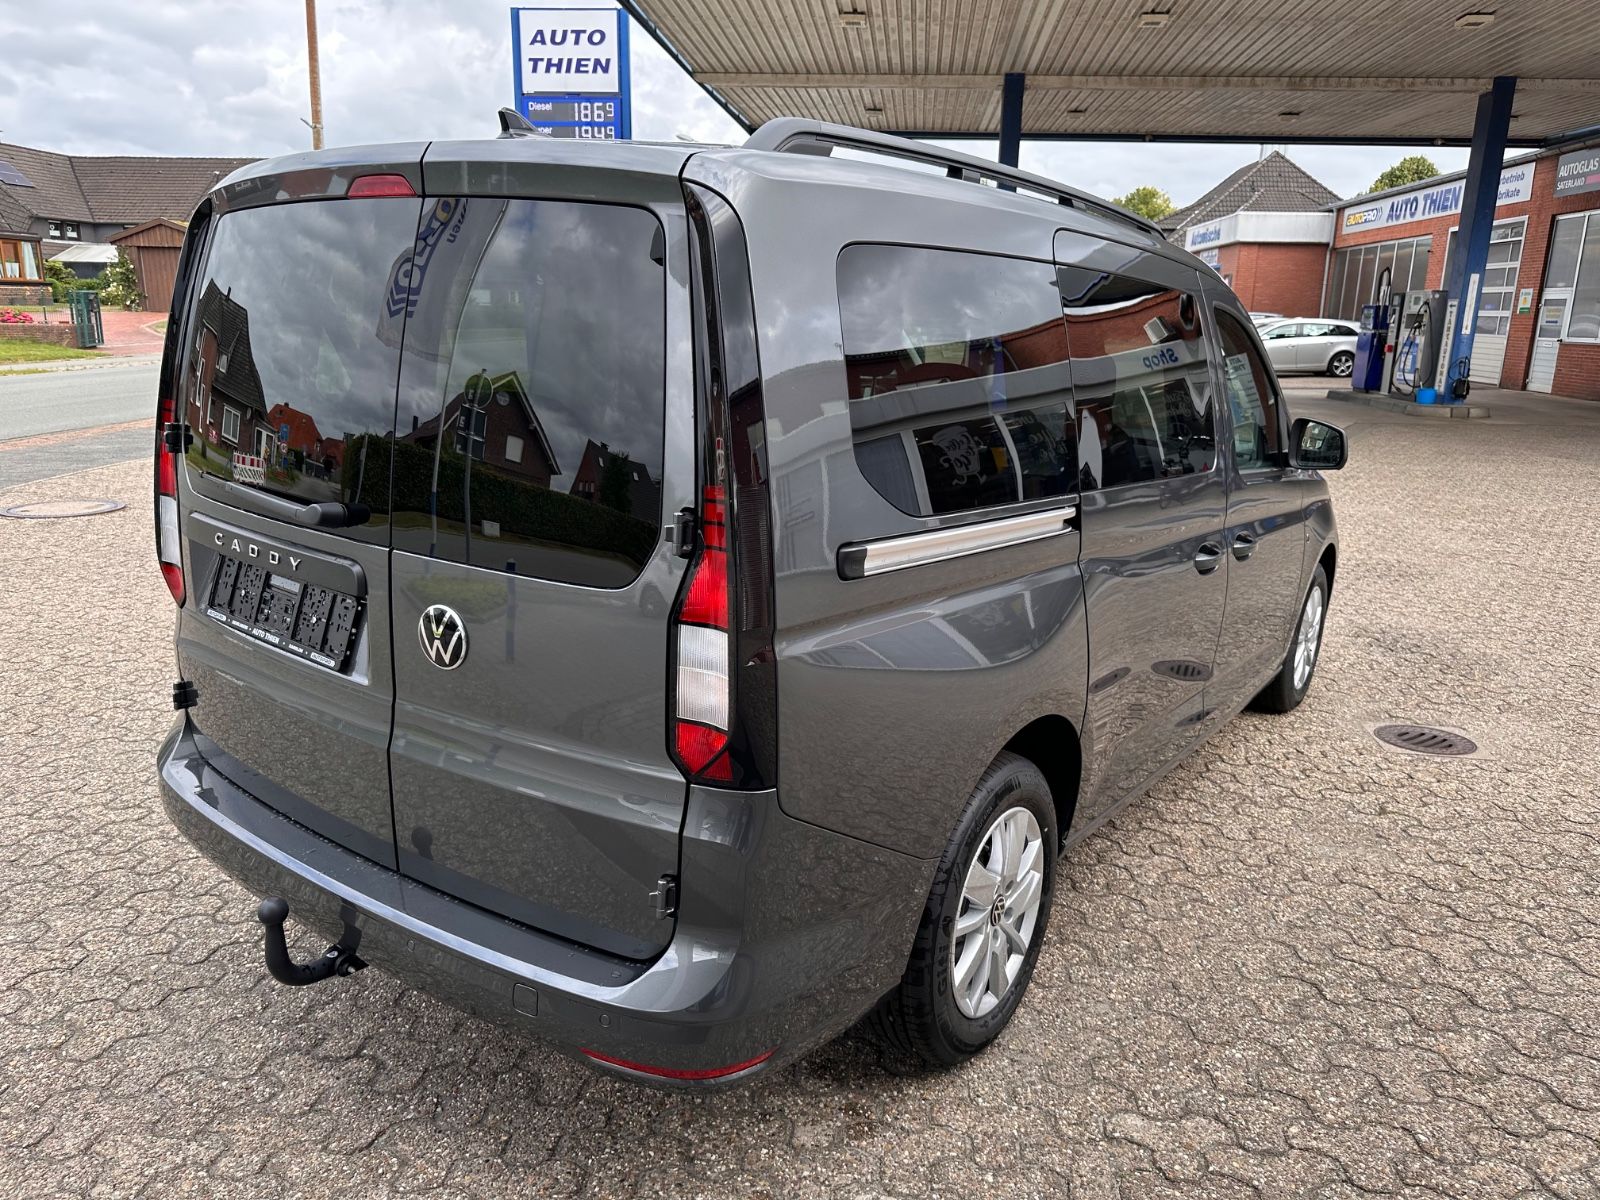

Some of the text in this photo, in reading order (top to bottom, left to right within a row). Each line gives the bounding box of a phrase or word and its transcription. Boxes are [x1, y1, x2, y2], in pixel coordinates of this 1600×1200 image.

[529, 29, 606, 46] AUTO
[528, 57, 611, 74] THIEN
[528, 101, 553, 111] Diesel
[1558, 157, 1600, 178] AUTOGLAS
[1556, 177, 1585, 190] SATERLAND
[1497, 187, 1521, 200] brikate
[1386, 196, 1419, 223] AUTO
[1422, 185, 1463, 217] THIEN
[214, 532, 301, 571] CADDY
